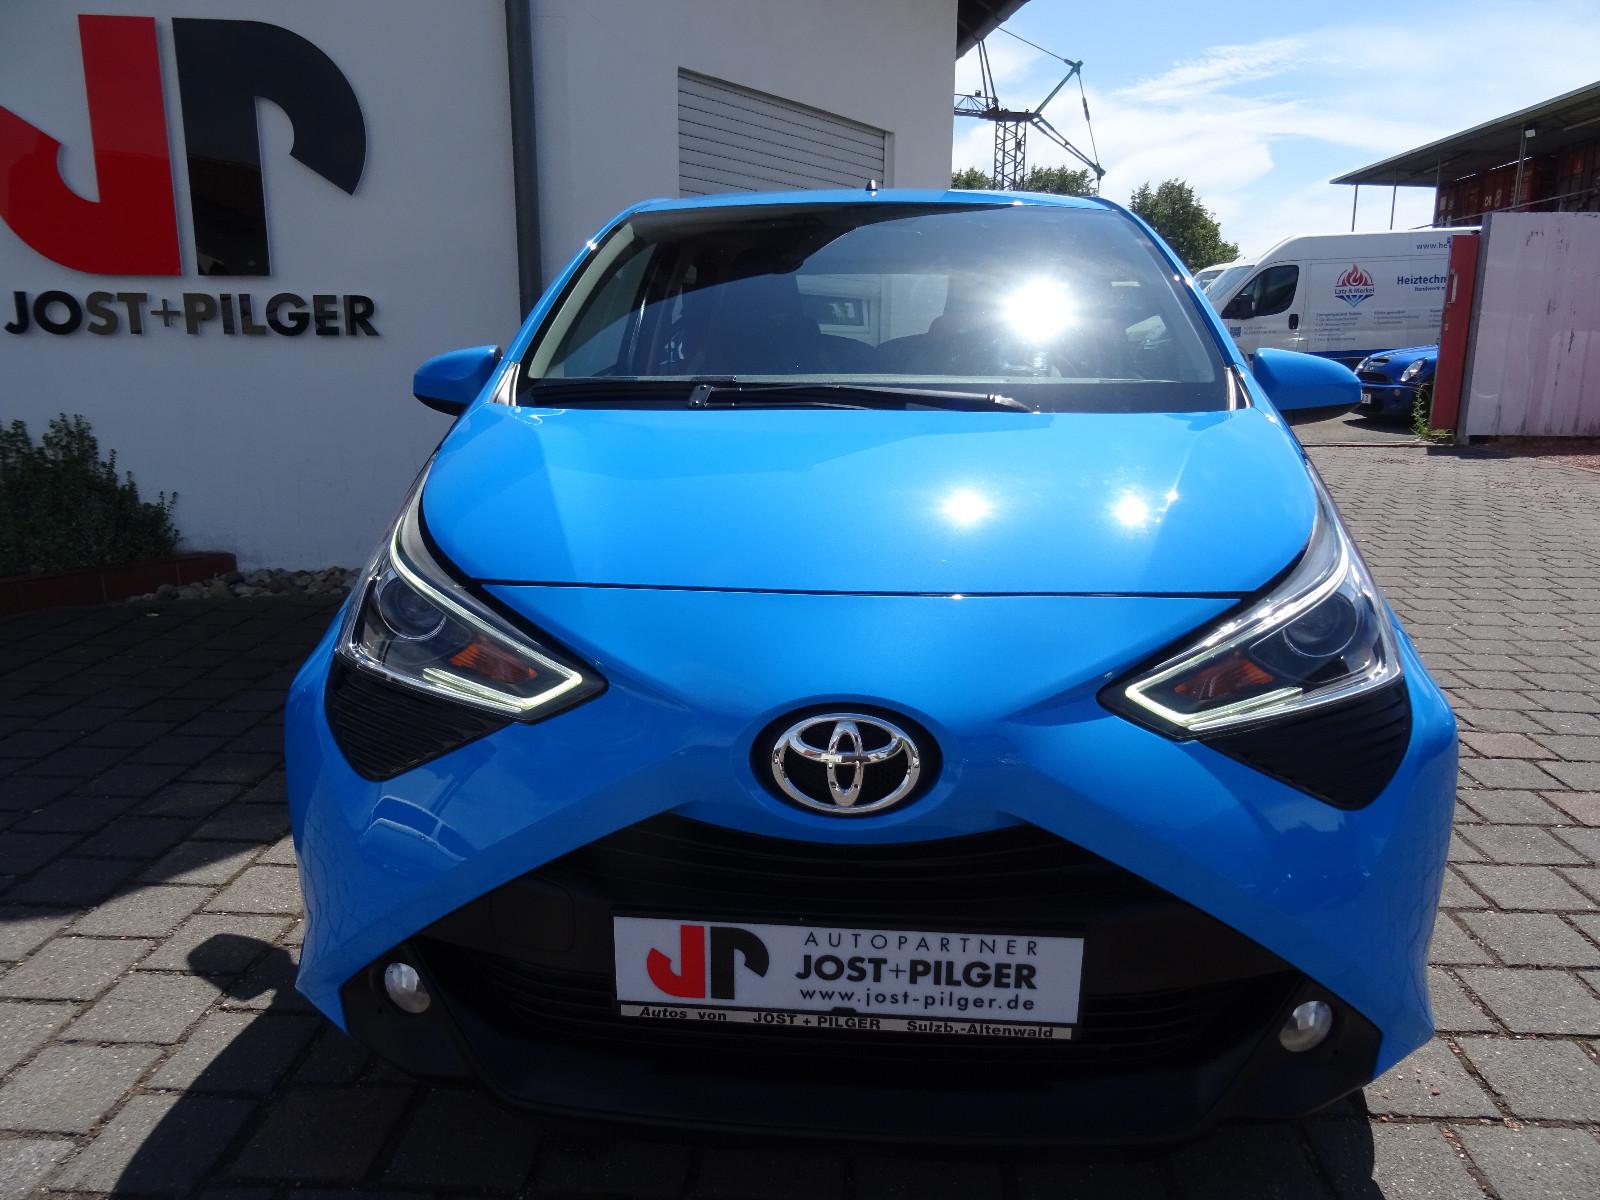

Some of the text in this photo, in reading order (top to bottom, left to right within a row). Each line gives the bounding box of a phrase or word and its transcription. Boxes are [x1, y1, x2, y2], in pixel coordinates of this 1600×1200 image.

[4, 290, 380, 337] JOST+PILGER
[804, 931, 1037, 956] AUTOPARTNER
[795, 954, 1037, 990] JOST+PILGER
[800, 987, 1035, 1011] www.jost-pilger.de
[640, 1006, 688, 1019] Autos
[697, 1010, 727, 1021] von
[753, 1012, 797, 1025] JOST
[817, 1015, 881, 1029] PILGER
[907, 1020, 1054, 1038] Sulzb.-Altenwald
